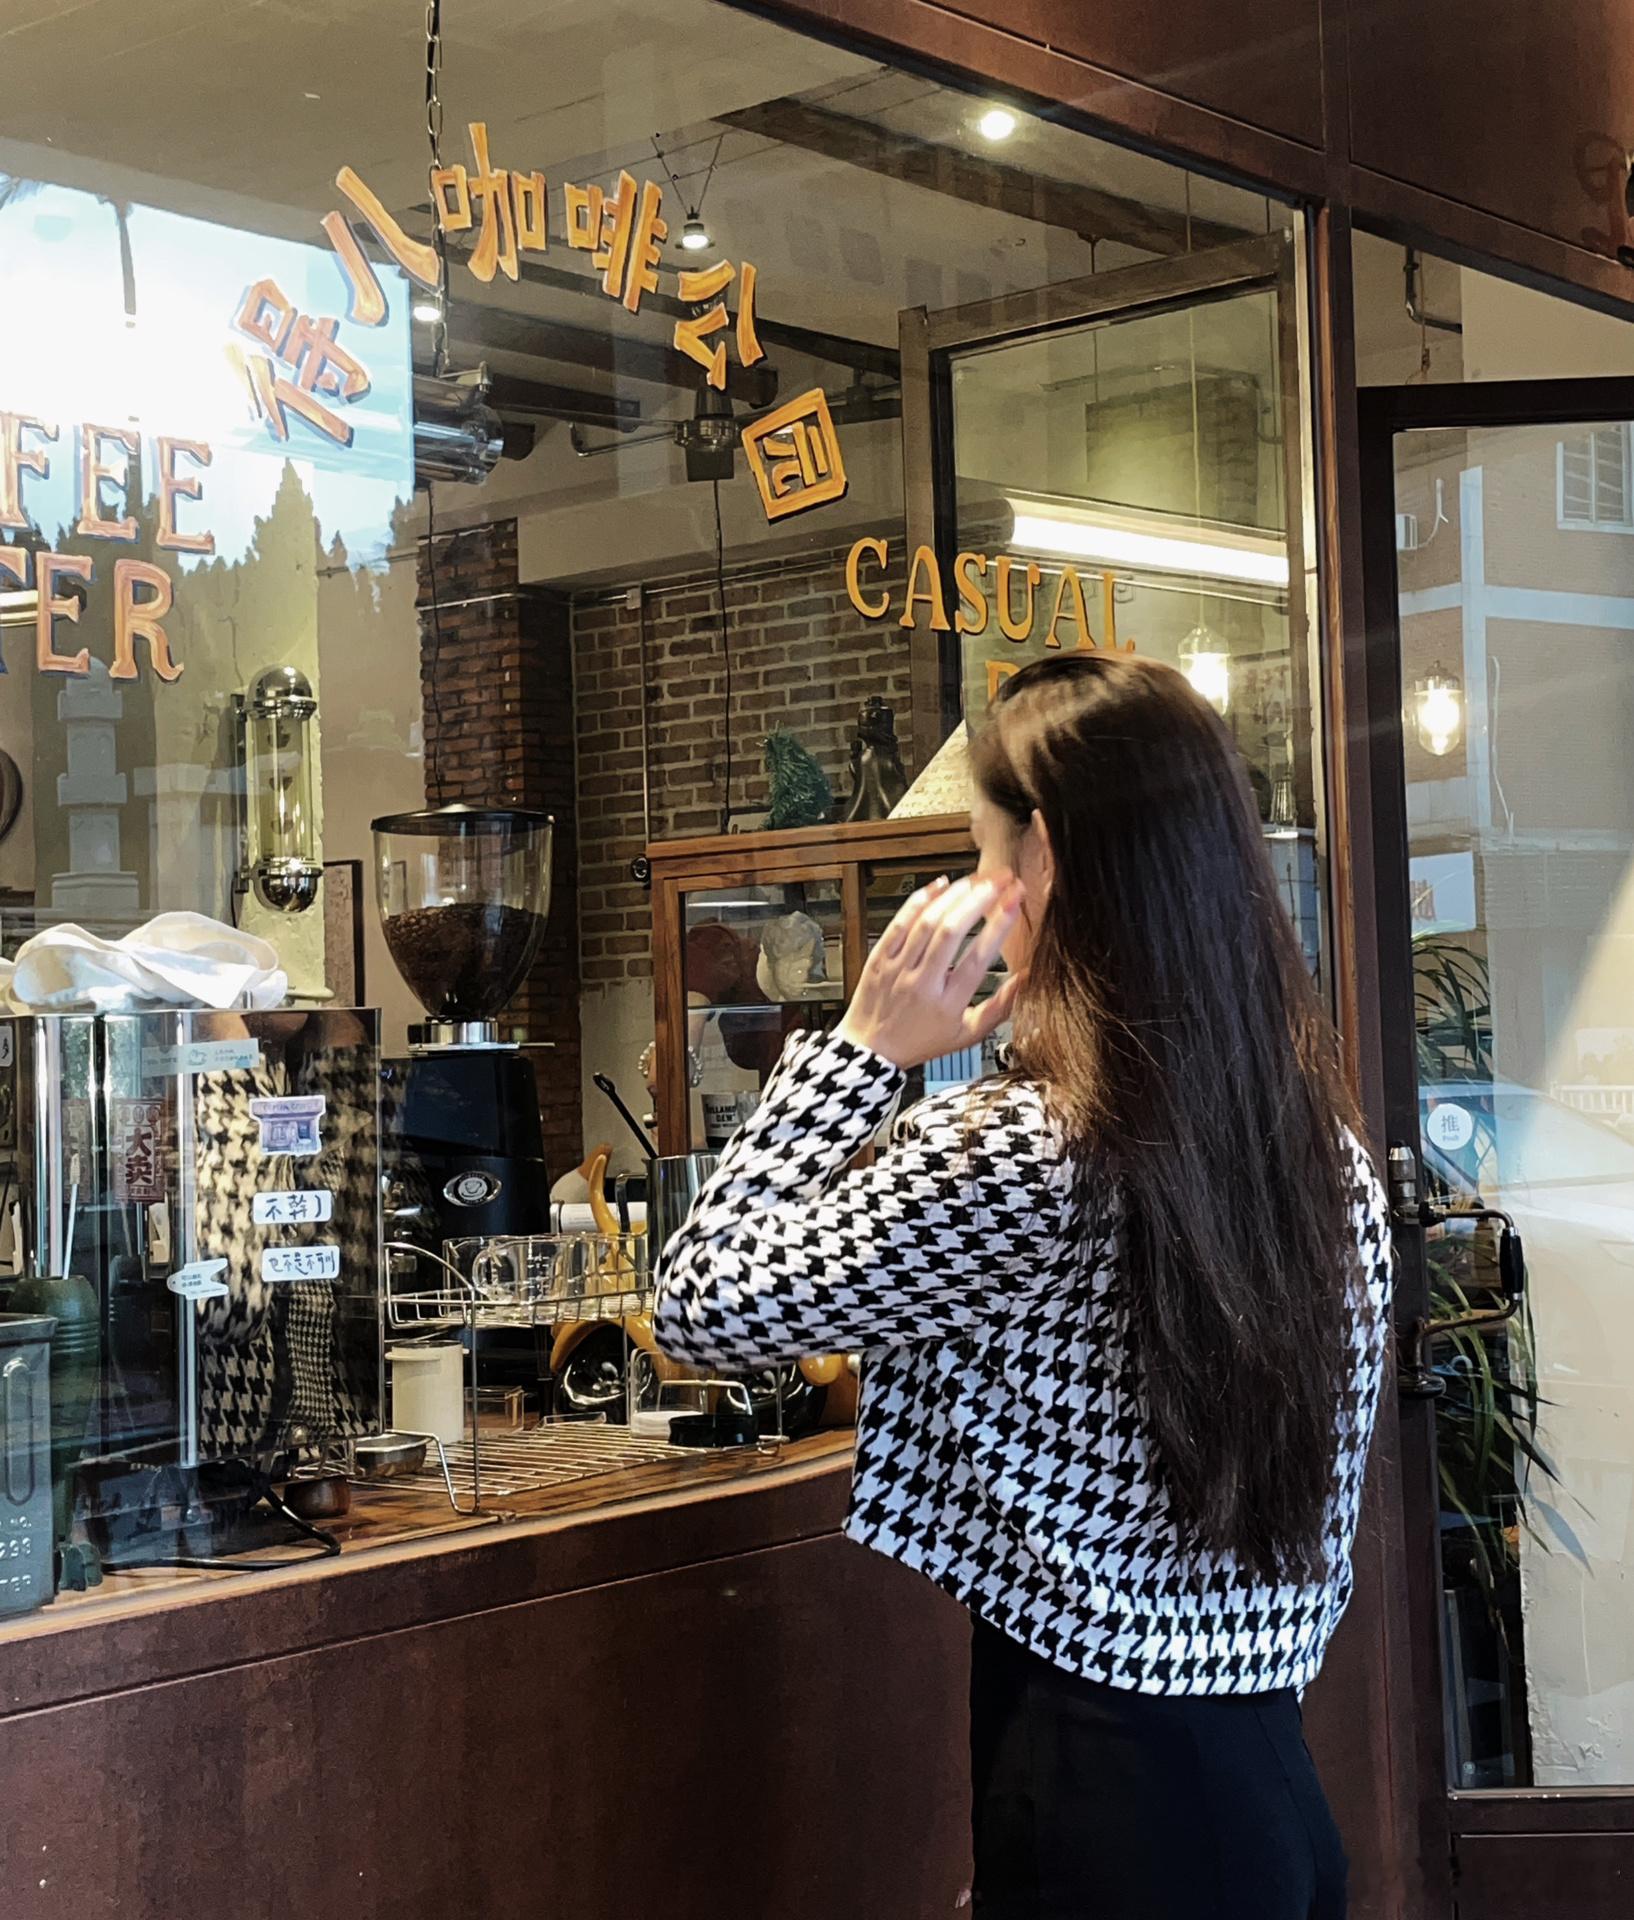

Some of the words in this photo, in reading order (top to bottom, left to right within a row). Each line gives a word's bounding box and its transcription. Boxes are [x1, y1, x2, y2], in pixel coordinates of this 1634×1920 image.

[845, 536, 1136, 653] CASUAL
[1441, 1114, 1460, 1133] 推
[125, 1127, 153, 1185] 大卖
